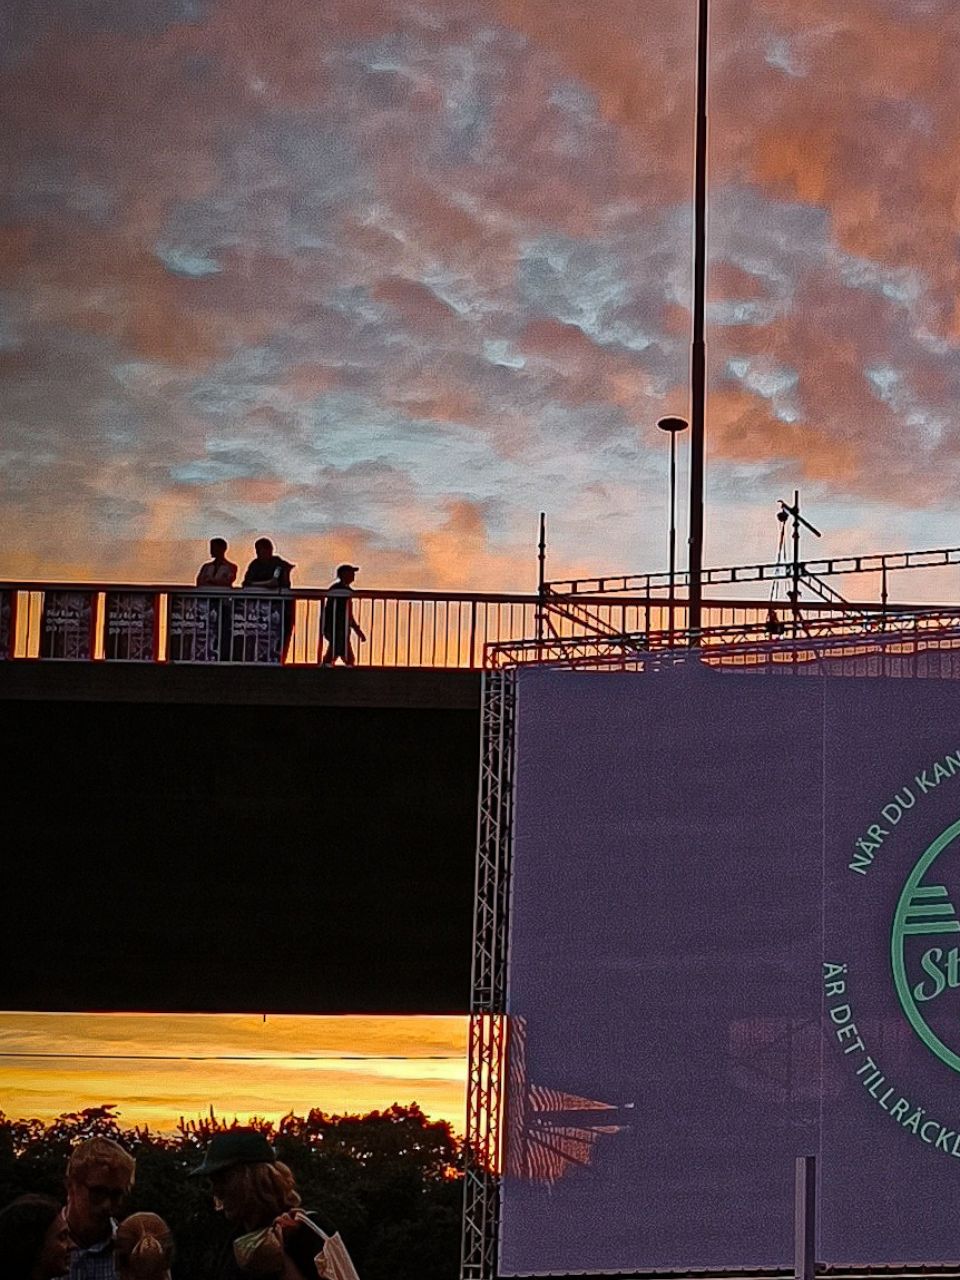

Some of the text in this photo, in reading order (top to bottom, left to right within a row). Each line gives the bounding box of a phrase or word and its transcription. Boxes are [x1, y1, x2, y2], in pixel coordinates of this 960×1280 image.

[849, 825, 889, 874] NÄR
[881, 790, 916, 824] DU
[823, 962, 848, 996] ÄR
[828, 1003, 865, 1054] DET
